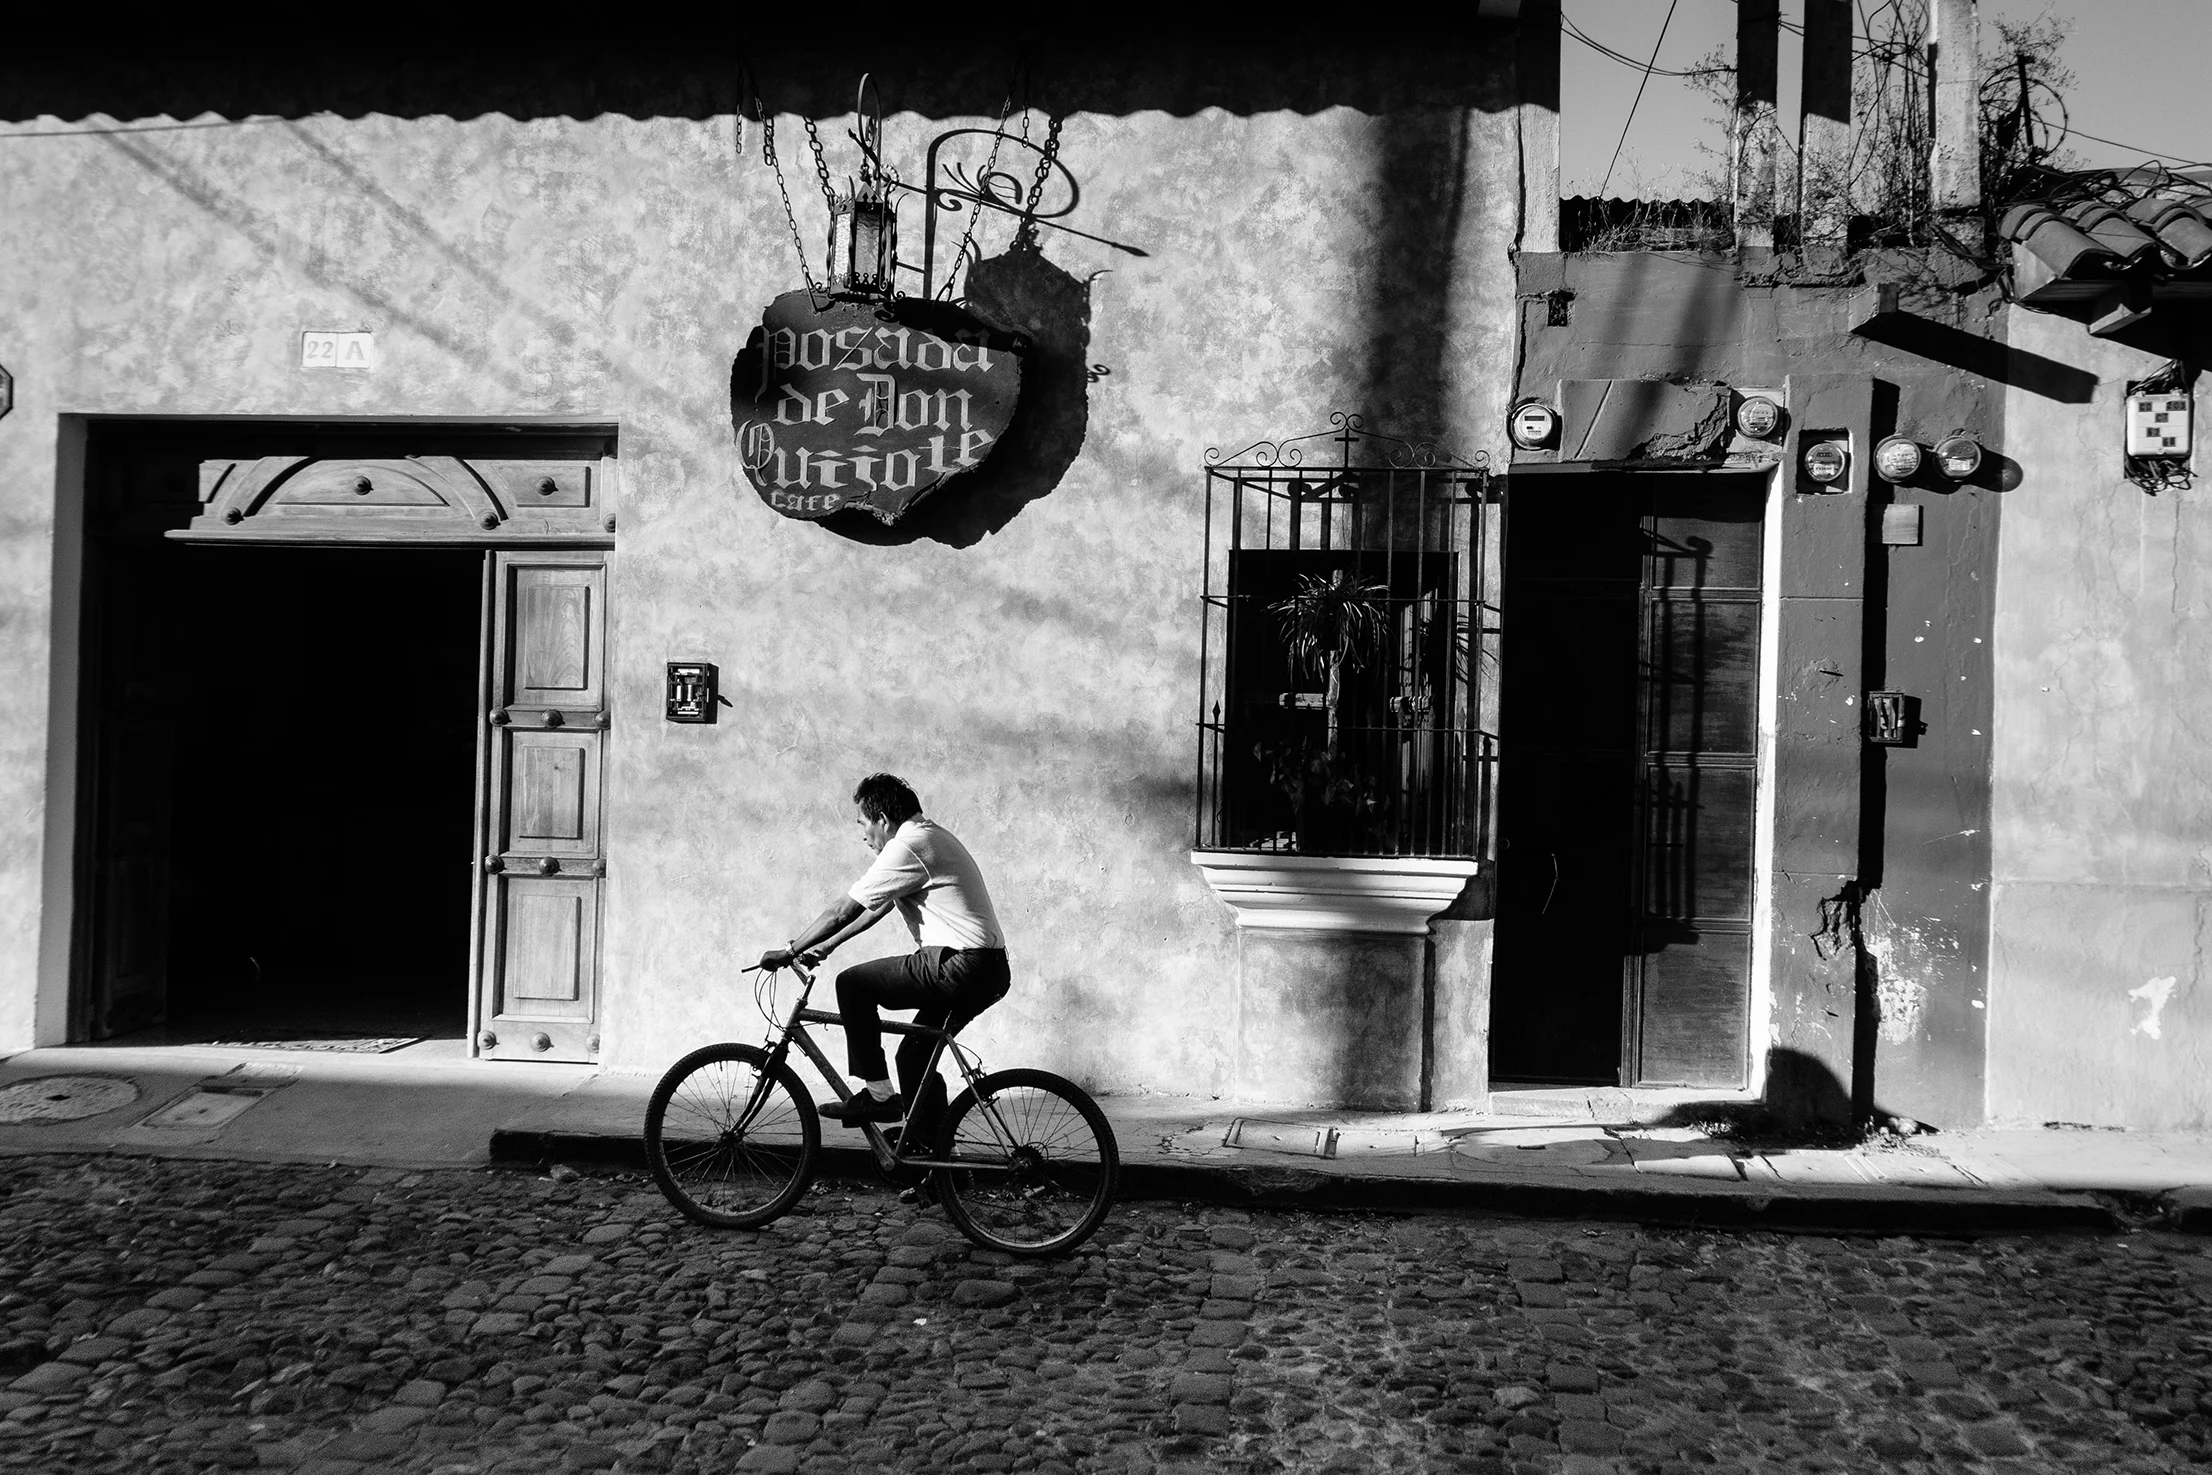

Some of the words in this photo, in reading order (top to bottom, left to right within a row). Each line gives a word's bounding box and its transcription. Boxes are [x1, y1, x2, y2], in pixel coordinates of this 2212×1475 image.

[772, 383, 850, 425] de
[854, 373, 976, 437] Don
[735, 418, 995, 491] Quijote
